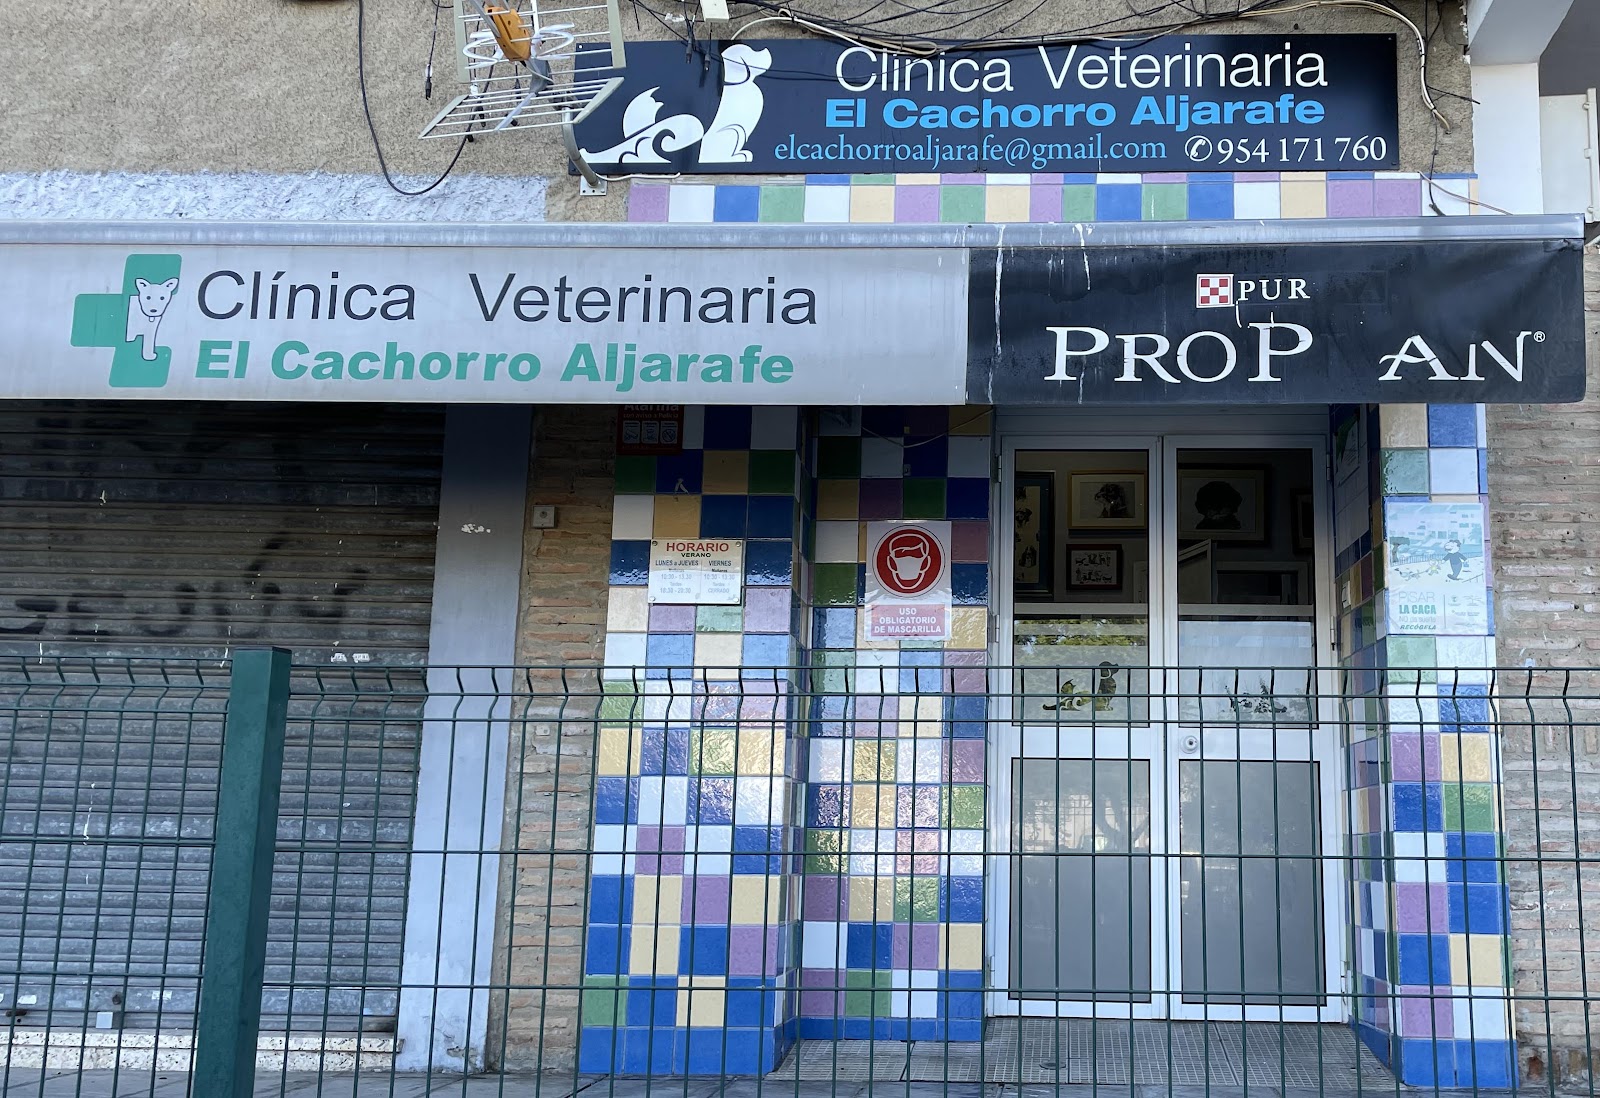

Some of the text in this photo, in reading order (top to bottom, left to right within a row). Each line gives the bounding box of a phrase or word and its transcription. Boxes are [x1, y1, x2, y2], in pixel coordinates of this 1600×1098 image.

[1037, 42, 1328, 90] Veterinaria
[825, 94, 1325, 132] El Cachorro Aljarafe
[774, 132, 1167, 171] elcachorroaljarafe@gmail.com
[1217, 135, 1387, 164] 954 171 760
[197, 269, 817, 325] Clínica Veterinaria
[195, 340, 794, 393] El Cachorro Aljarafe
[666, 542, 729, 552] HORARIO
[1399, 605, 1436, 614] LA CACA
